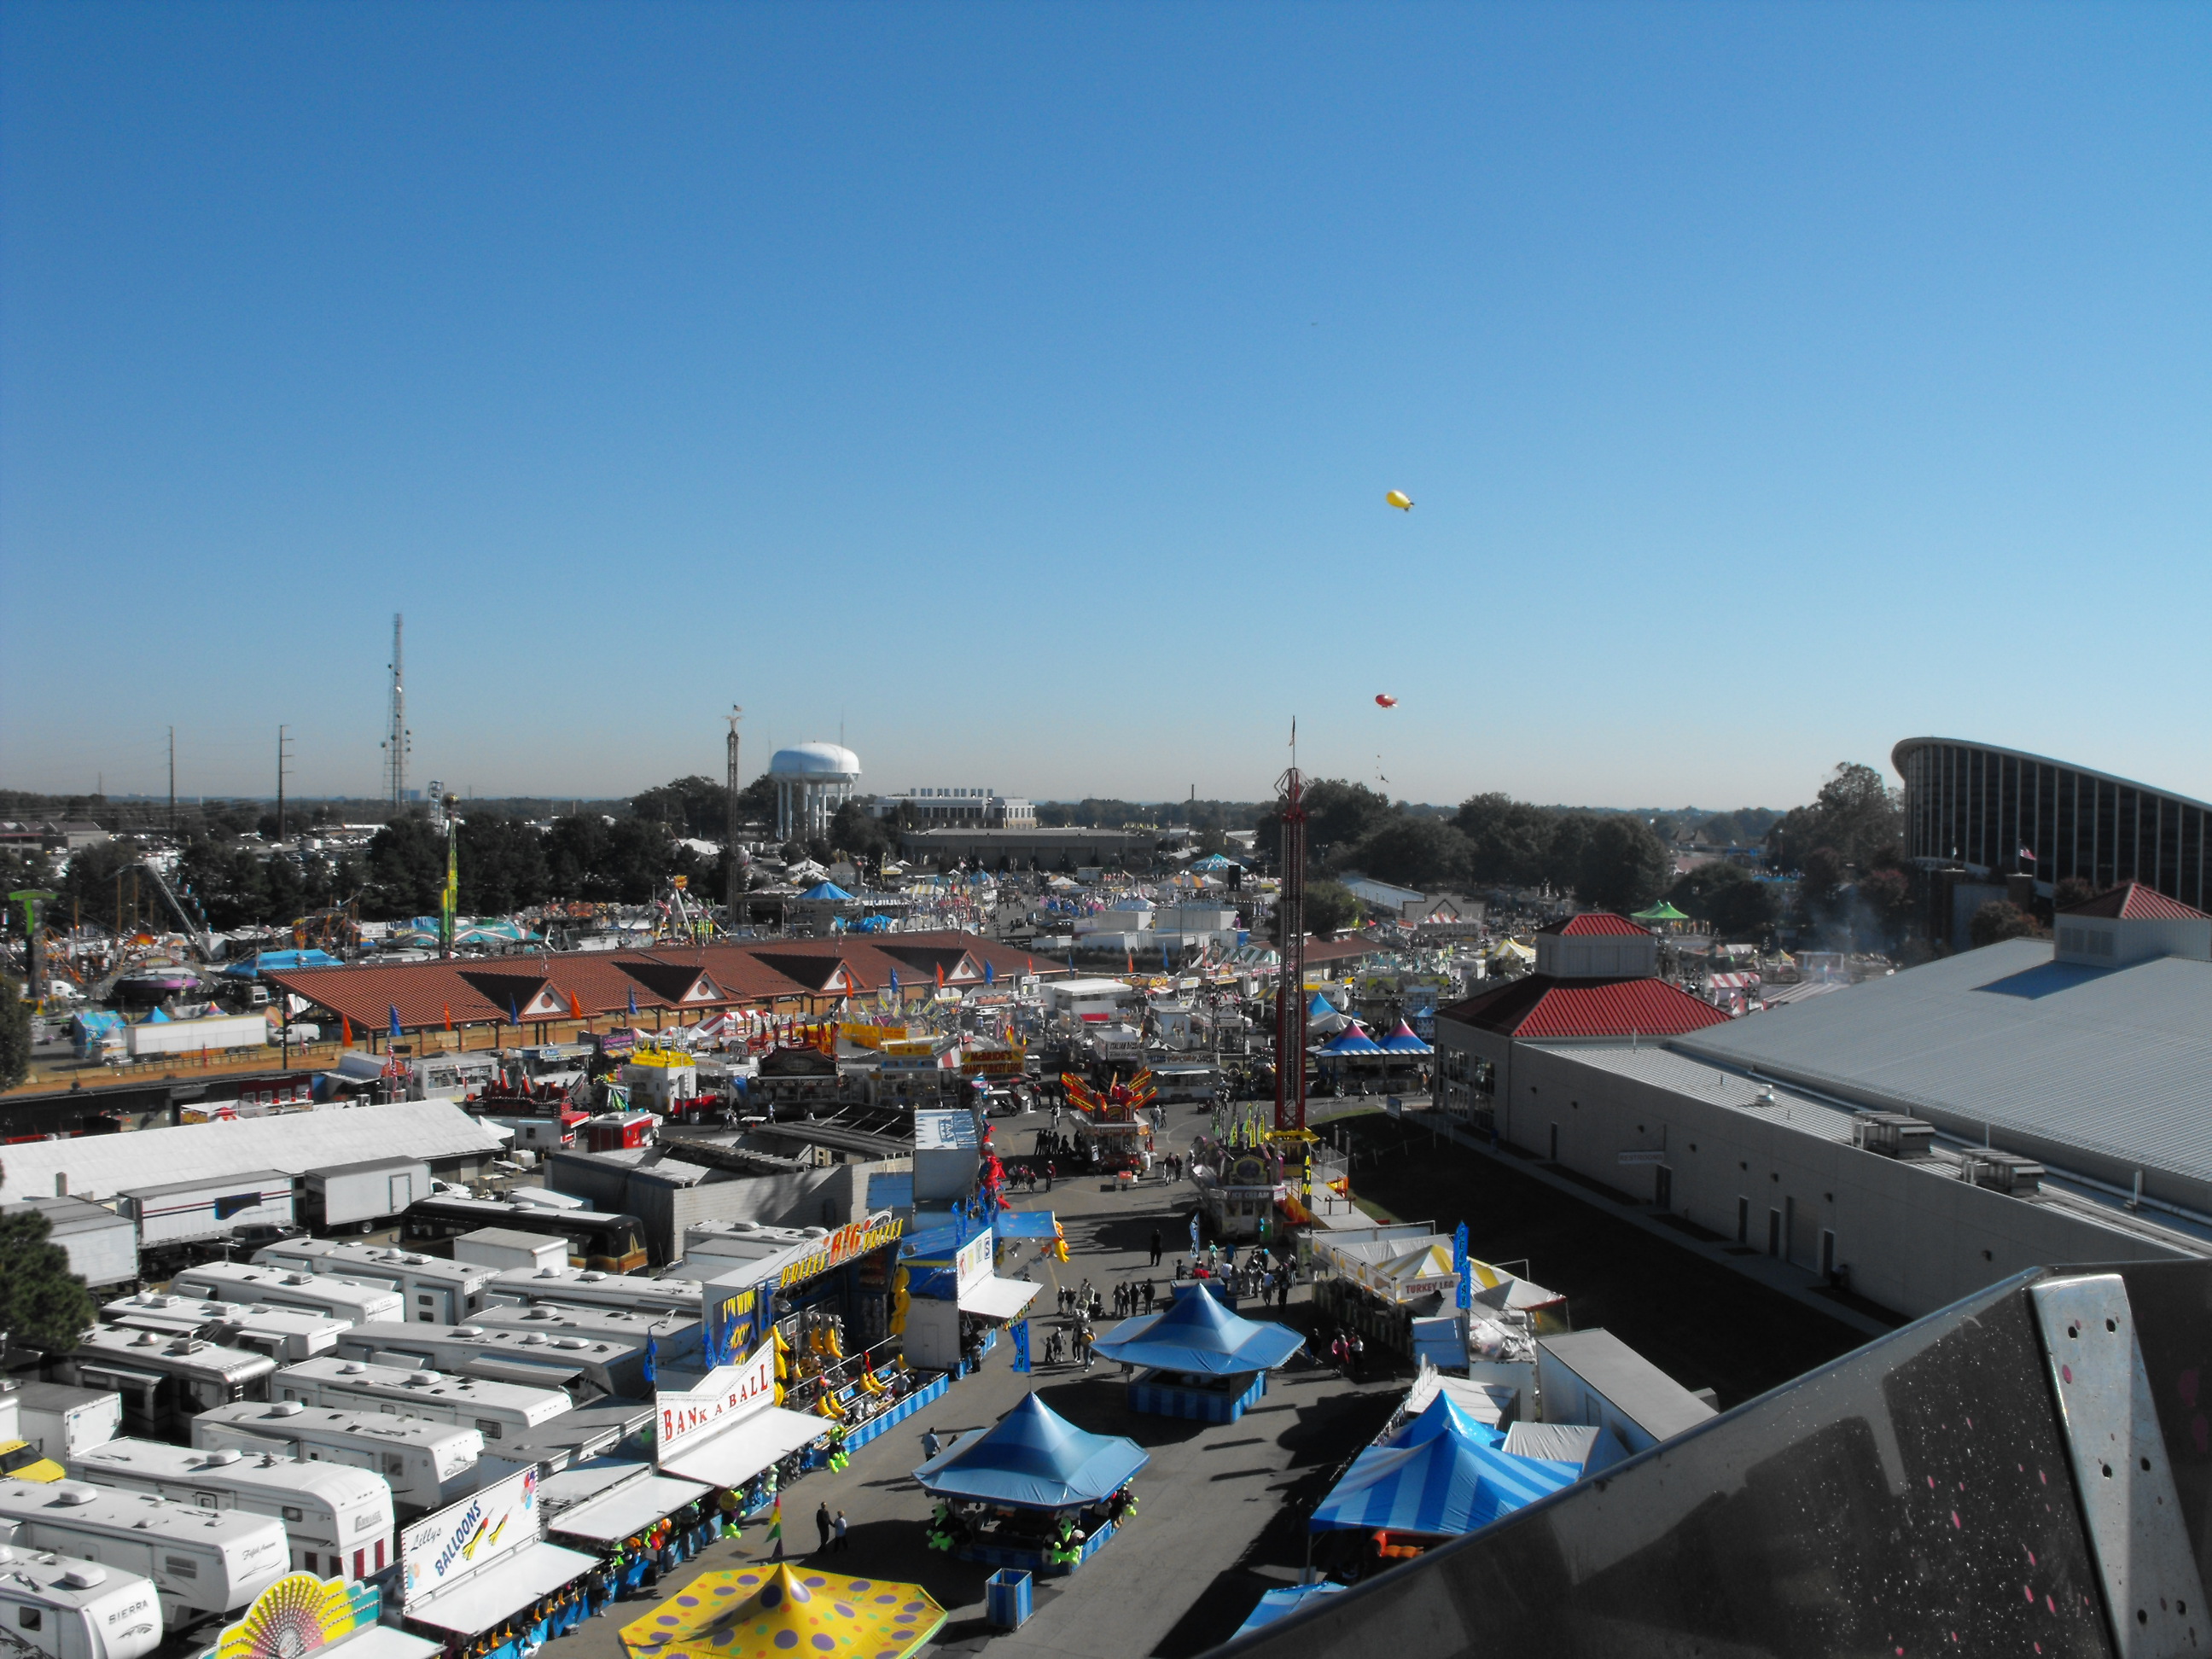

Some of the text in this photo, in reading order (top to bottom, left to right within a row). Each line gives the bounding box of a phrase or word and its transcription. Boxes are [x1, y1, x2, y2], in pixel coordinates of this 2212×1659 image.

[1301, 1155, 1312, 1196] ATM
[780, 1249, 826, 1289] PRIZES
[828, 1222, 861, 1266] BIG
[862, 1218, 905, 1253] PRIZES
[959, 1238, 991, 1277] TOYS
[1405, 1281, 1439, 1295] TURKEY
[663, 1364, 768, 1441] BANK A BALL
[434, 1499, 481, 1577] BALLOONS
[108, 1599, 148, 1625] SIERRA
